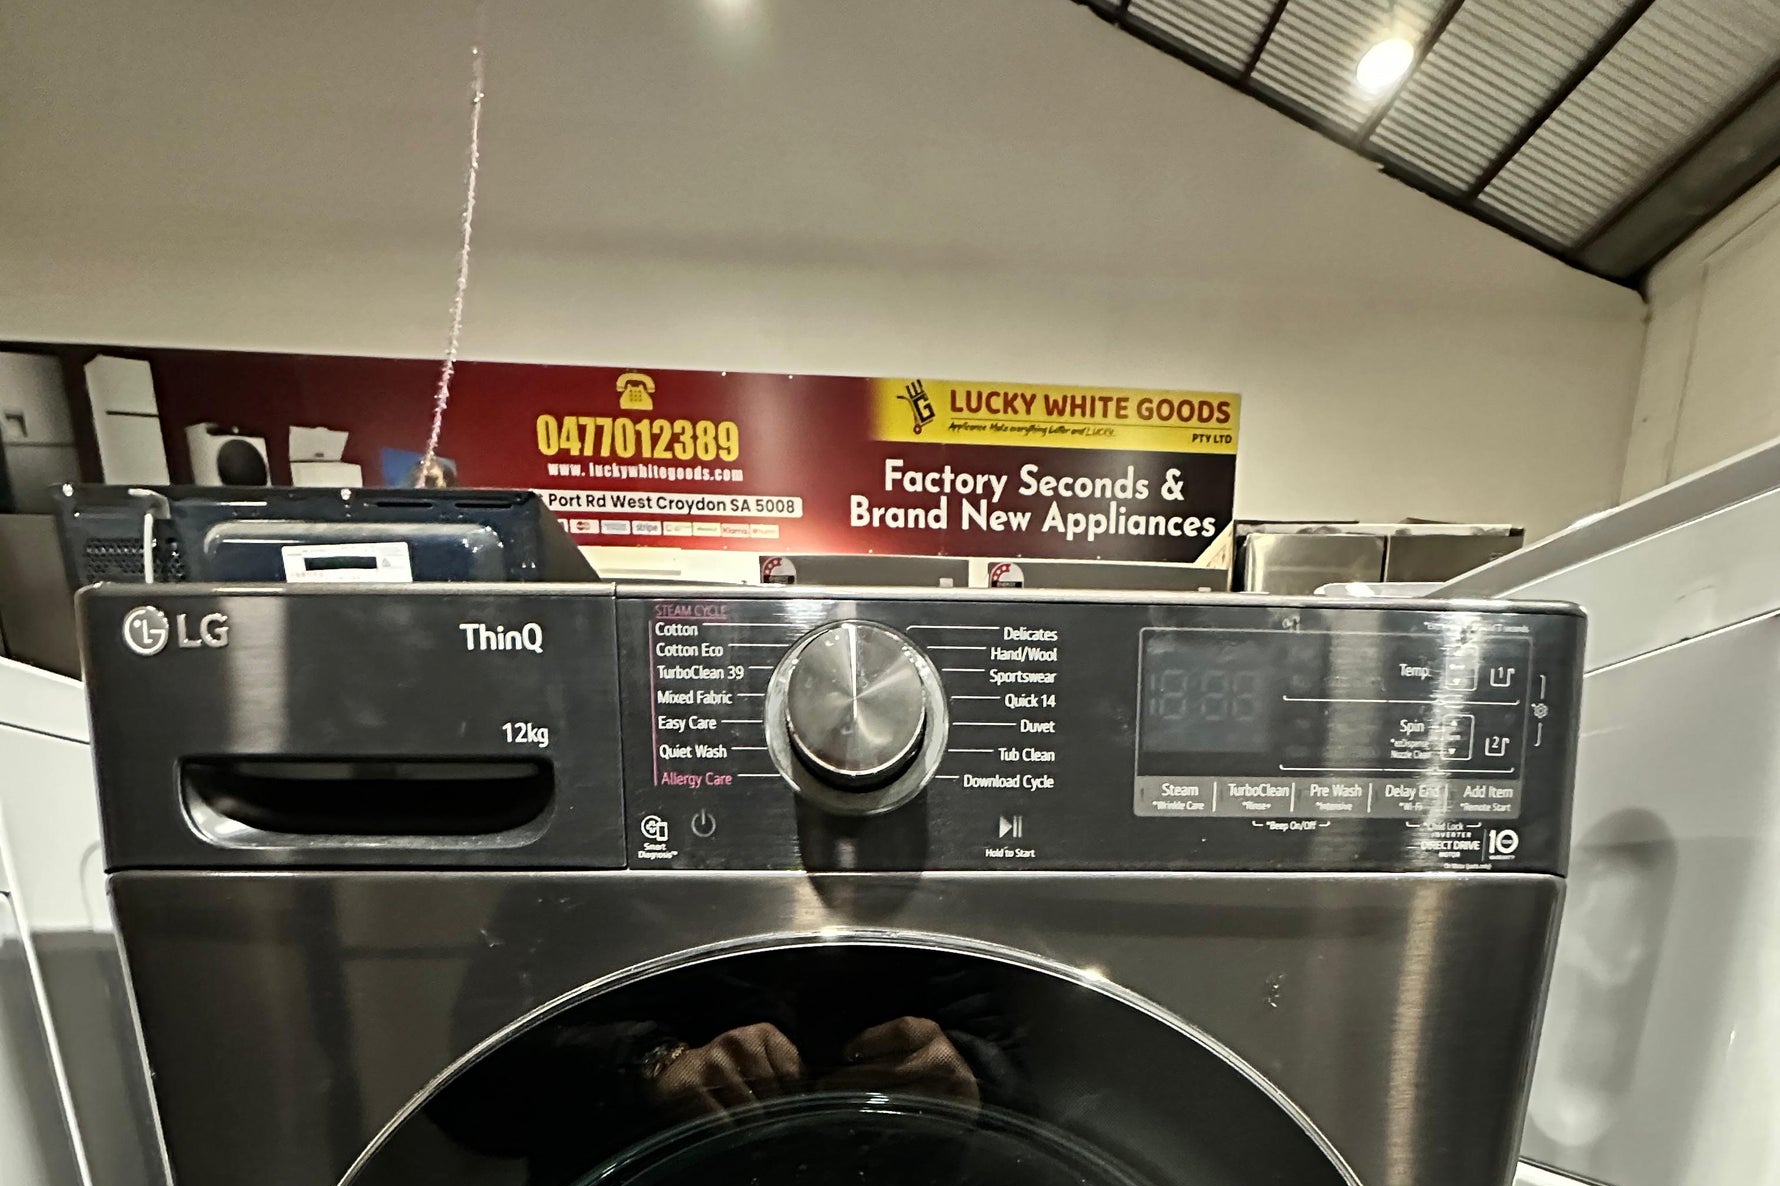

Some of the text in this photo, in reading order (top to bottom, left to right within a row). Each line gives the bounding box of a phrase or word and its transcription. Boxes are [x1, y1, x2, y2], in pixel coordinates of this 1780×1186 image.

[950, 389, 1231, 424] LUCKY WHITE GOODS
[537, 414, 740, 462] 0477012389
[1192, 432, 1232, 445] PTY LTD
[884, 458, 1185, 503] Factory Seconds &
[548, 493, 796, 515] Port Rd West Croydon SA 5008
[850, 495, 1215, 542] Brand New Appliances
[655, 604, 727, 616] STEAM CYCLE
[177, 612, 229, 649] LG
[655, 621, 698, 636] Cotton
[1003, 626, 1058, 641] Delicates
[458, 622, 543, 654] ThinQ
[656, 642, 724, 657] Cotton Eco
[990, 646, 1058, 662] Hand/Wool
[657, 665, 745, 680] TurboClean 39
[989, 668, 1057, 686] Sportswear
[1399, 663, 1432, 680] Temp.
[657, 690, 732, 704] Mixed Fabric
[1004, 693, 1056, 709] Quick 14
[657, 715, 717, 732] Easy Care
[1020, 718, 1056, 733] Duvet
[1399, 719, 1425, 735] Spin
[502, 722, 549, 748] 12kg
[659, 744, 728, 759] Quiet Wash
[998, 747, 1056, 762] Tub Clean
[661, 771, 733, 788] Allergy Care
[963, 774, 1055, 792] Download Cycle
[1161, 782, 1199, 797] Steam
[1227, 783, 1290, 797] TurboClean
[1309, 783, 1362, 798] Pre Wash
[1385, 784, 1417, 801] Delay
[1463, 785, 1514, 798] Add Item
[985, 848, 1036, 858] Hold to Start
